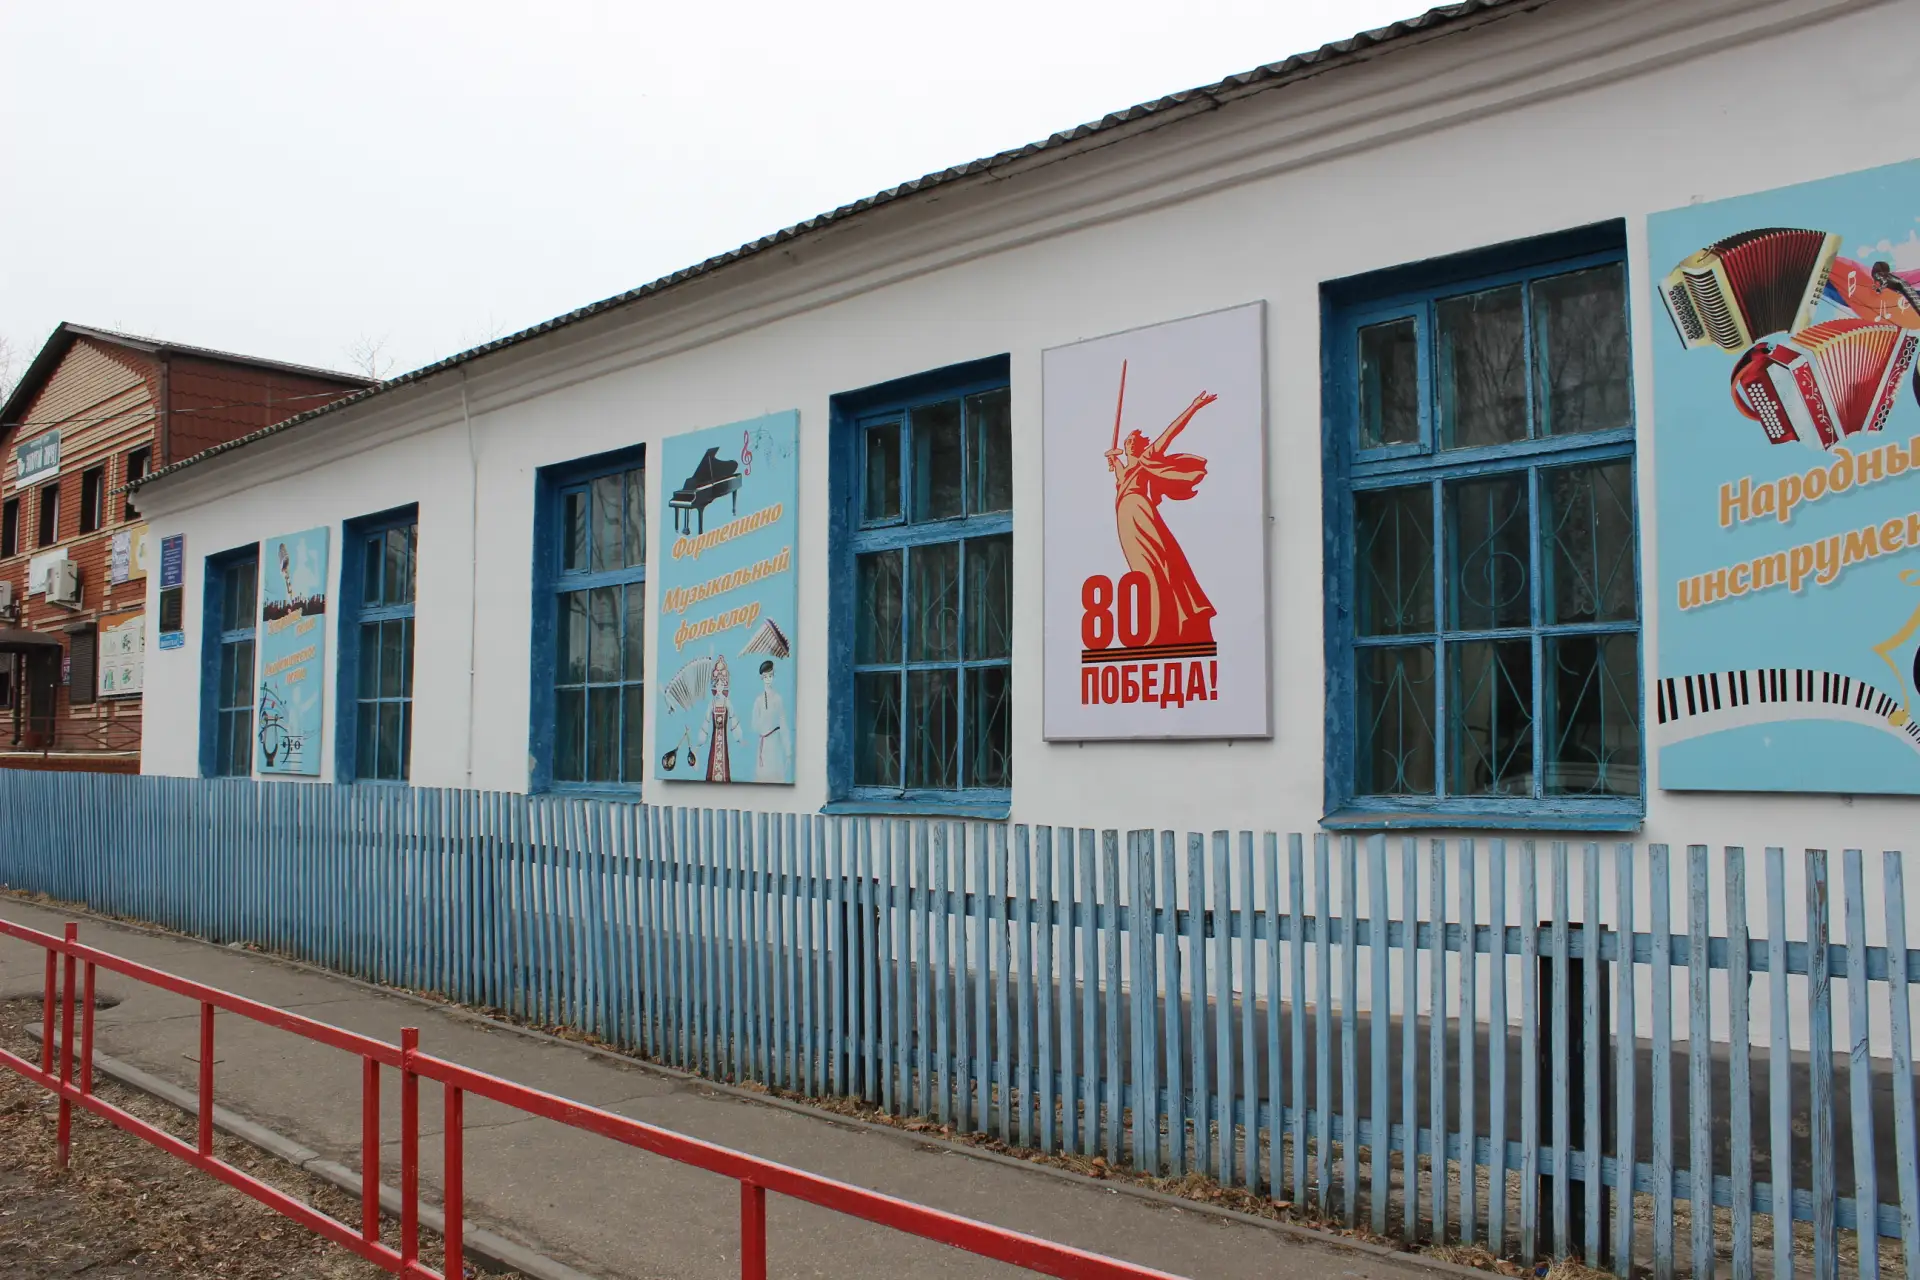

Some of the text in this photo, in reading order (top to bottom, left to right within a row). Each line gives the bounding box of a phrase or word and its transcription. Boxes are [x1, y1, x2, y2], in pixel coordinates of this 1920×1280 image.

[1720, 435, 1920, 526] Народны
[672, 503, 783, 559] Фортепиано
[662, 546, 791, 614] Музыкальный
[1081, 571, 1152, 650] 80
[674, 601, 761, 652] фольклор
[1081, 660, 1218, 709] ПОБЕДА!
